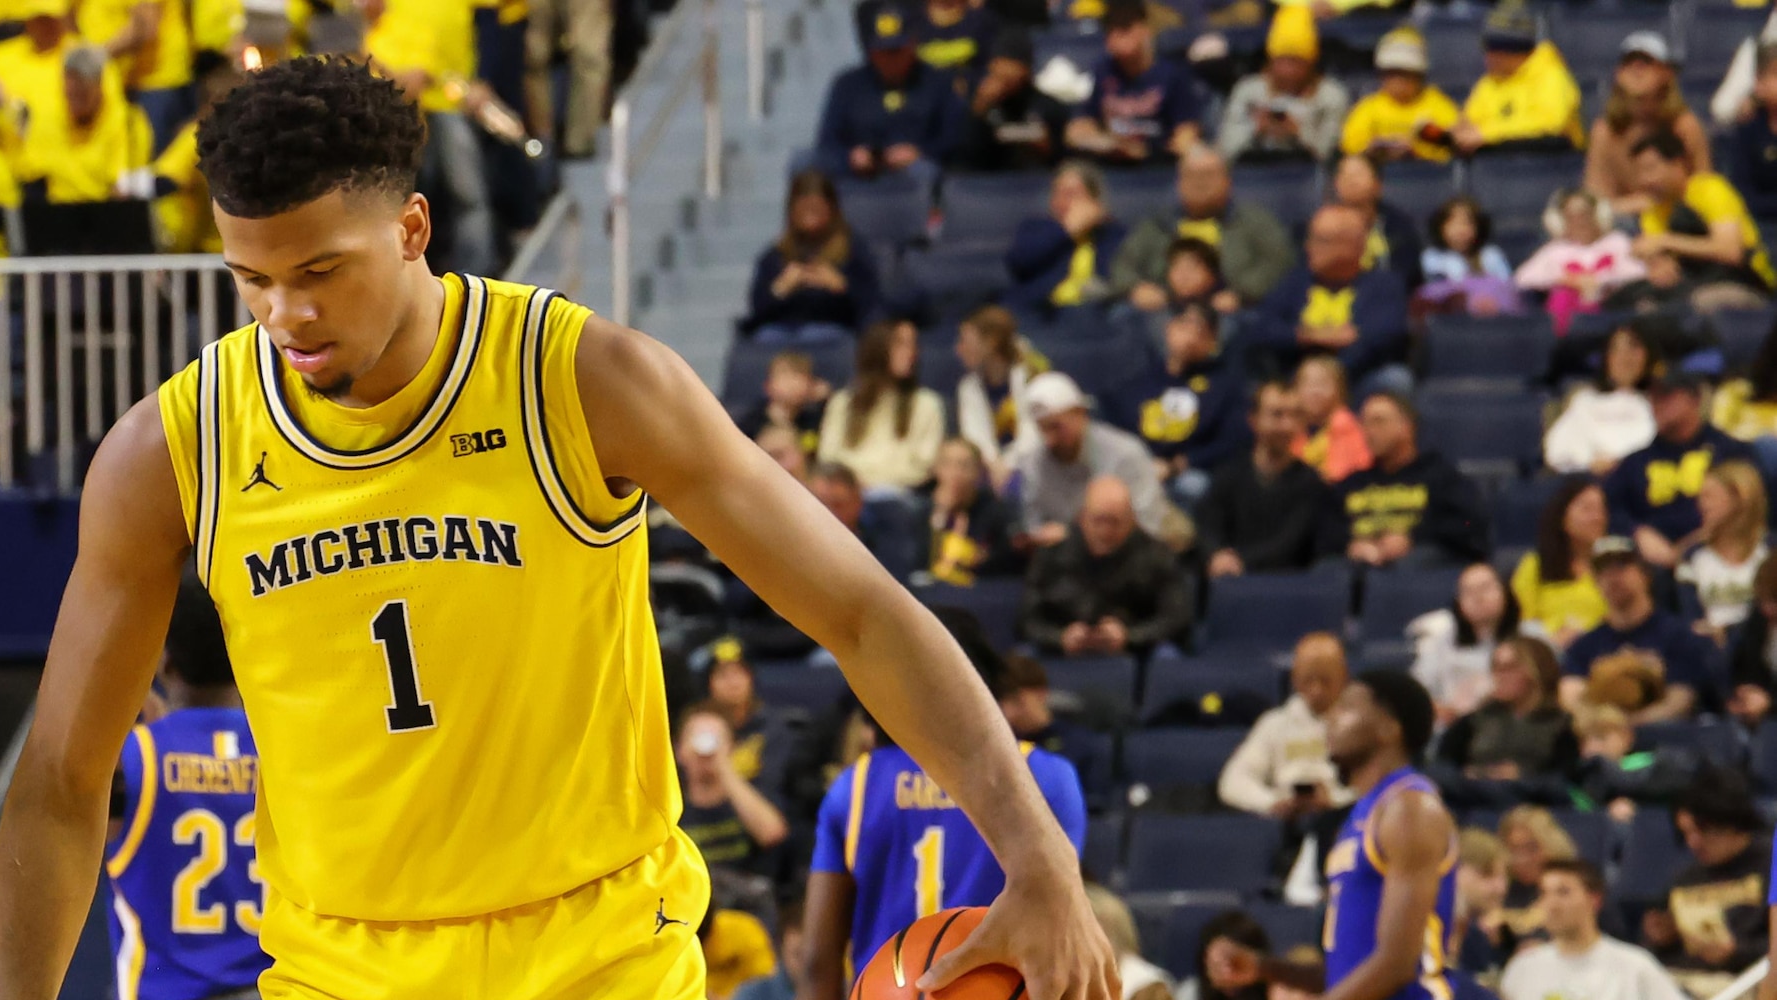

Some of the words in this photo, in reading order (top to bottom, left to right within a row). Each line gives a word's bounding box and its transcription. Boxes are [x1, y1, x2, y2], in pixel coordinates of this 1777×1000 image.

[243, 513, 525, 599] MICHIGAN
[369, 597, 438, 734] 1
[172, 808, 271, 937] 23
[913, 825, 945, 920] 1
